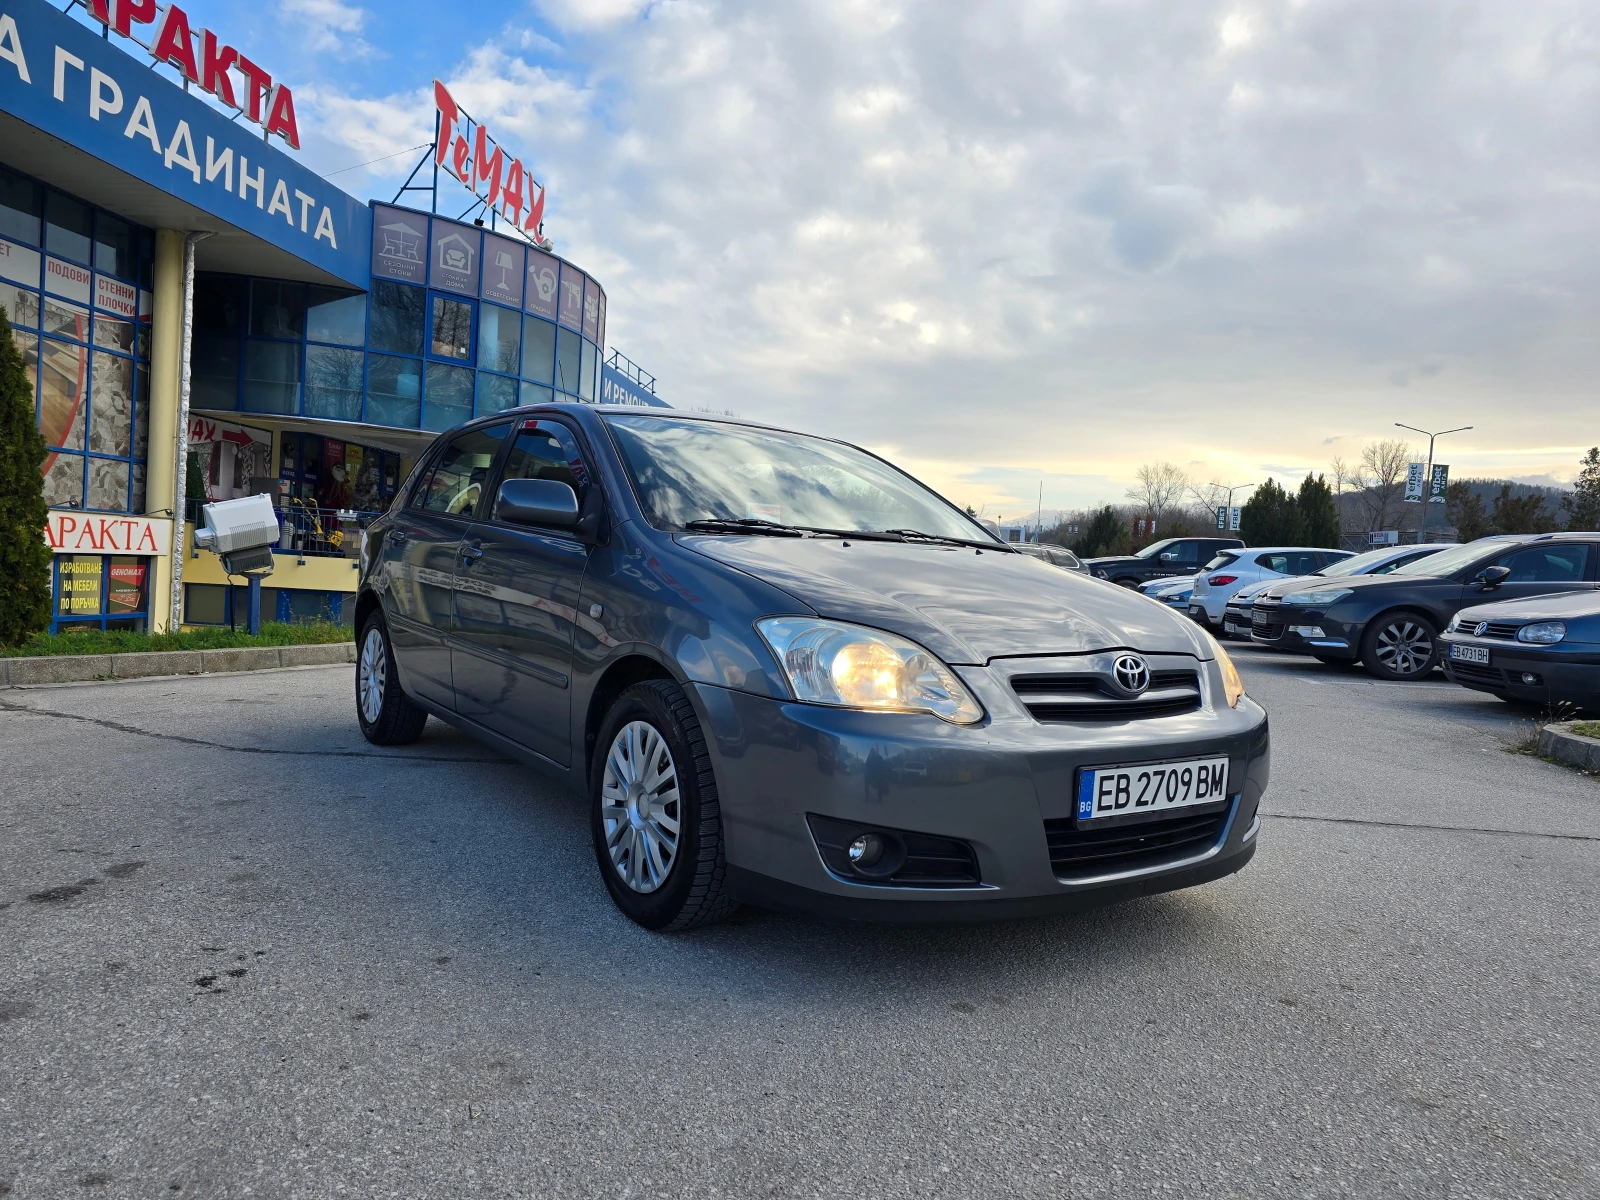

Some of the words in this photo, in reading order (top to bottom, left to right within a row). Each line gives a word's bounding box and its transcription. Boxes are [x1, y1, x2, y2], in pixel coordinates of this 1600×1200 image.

[53, 45, 338, 250] ГРАДИНАТА
[48, 260, 90, 285] ПОДОВИ
[383, 260, 416, 271] СЕЗОННИ
[389, 268, 412, 277] СТОКИ
[98, 279, 134, 299] СТЕННИ
[445, 280, 465, 289] ДОМА
[98, 294, 135, 316] ПЛОЧКИ
[604, 377, 612, 400] И
[1408, 465, 1418, 492] efbet
[1432, 466, 1443, 494] efbet
[60, 562, 102, 574] ИЗРАБОТВАНЕ
[63, 580, 72, 592] НА
[72, 580, 98, 591] МЕБЕЛИ
[60, 598, 70, 610] ПО
[70, 598, 99, 610] ПОРЪЧКА
[1453, 646, 1461, 658] EB
[1461, 647, 1477, 660] 4731
[1478, 649, 1488, 662] BH
[1097, 773, 1131, 811] EB
[1135, 767, 1193, 807] 2709
[1196, 763, 1225, 799] BM
[1079, 801, 1092, 813] BG
